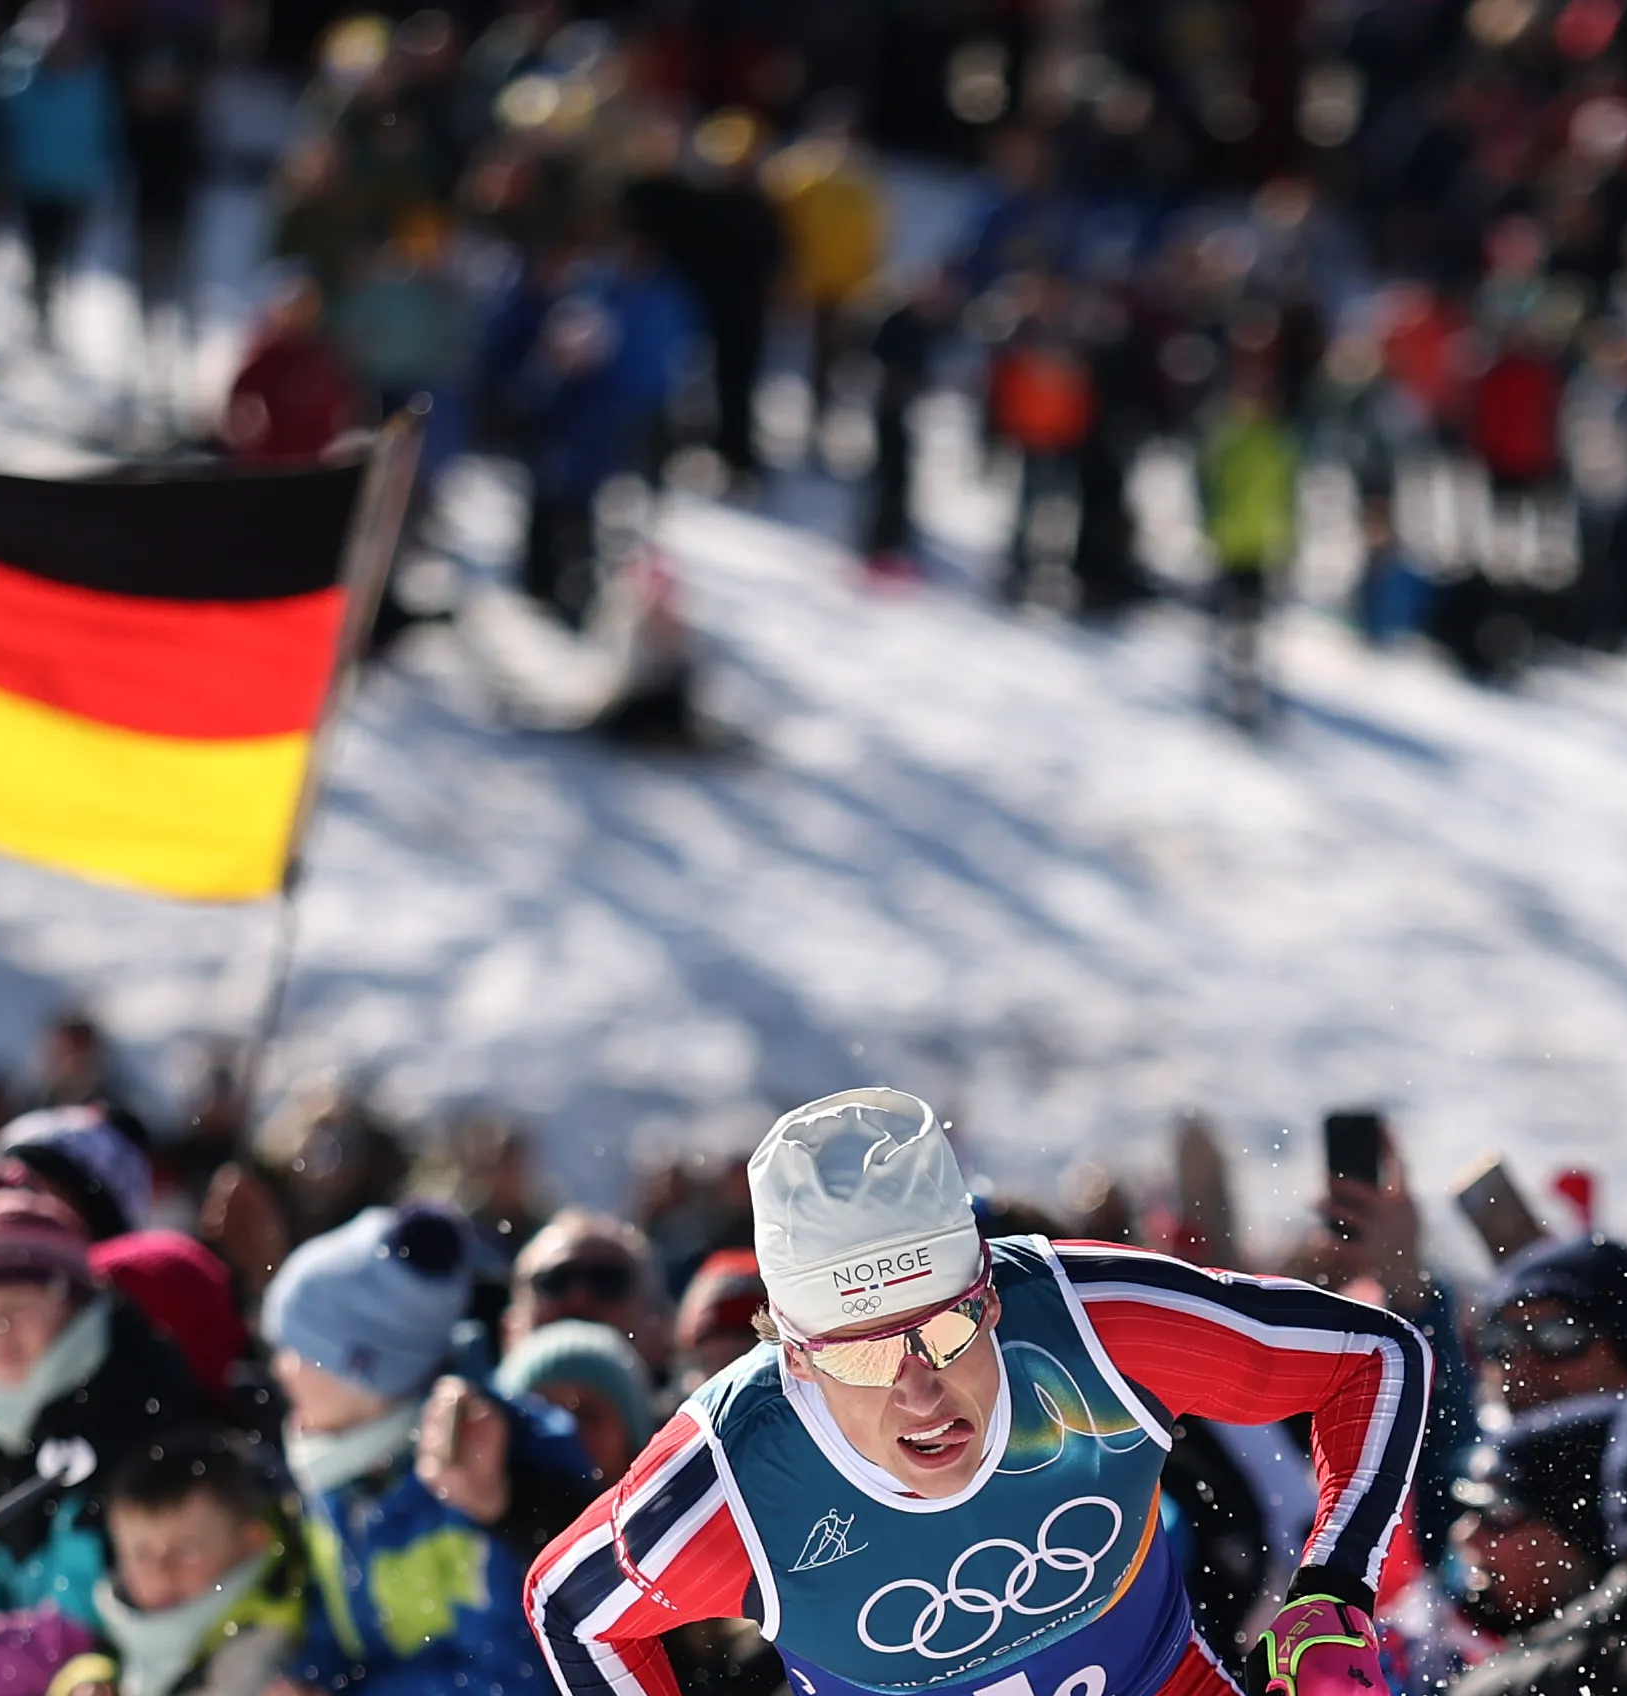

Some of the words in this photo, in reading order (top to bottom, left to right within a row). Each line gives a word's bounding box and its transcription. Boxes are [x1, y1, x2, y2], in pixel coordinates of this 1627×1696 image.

[833, 1246, 932, 1288] NORGE
[992, 1594, 1107, 1658] CORTINA
[1277, 1608, 1324, 1664] LEKI
